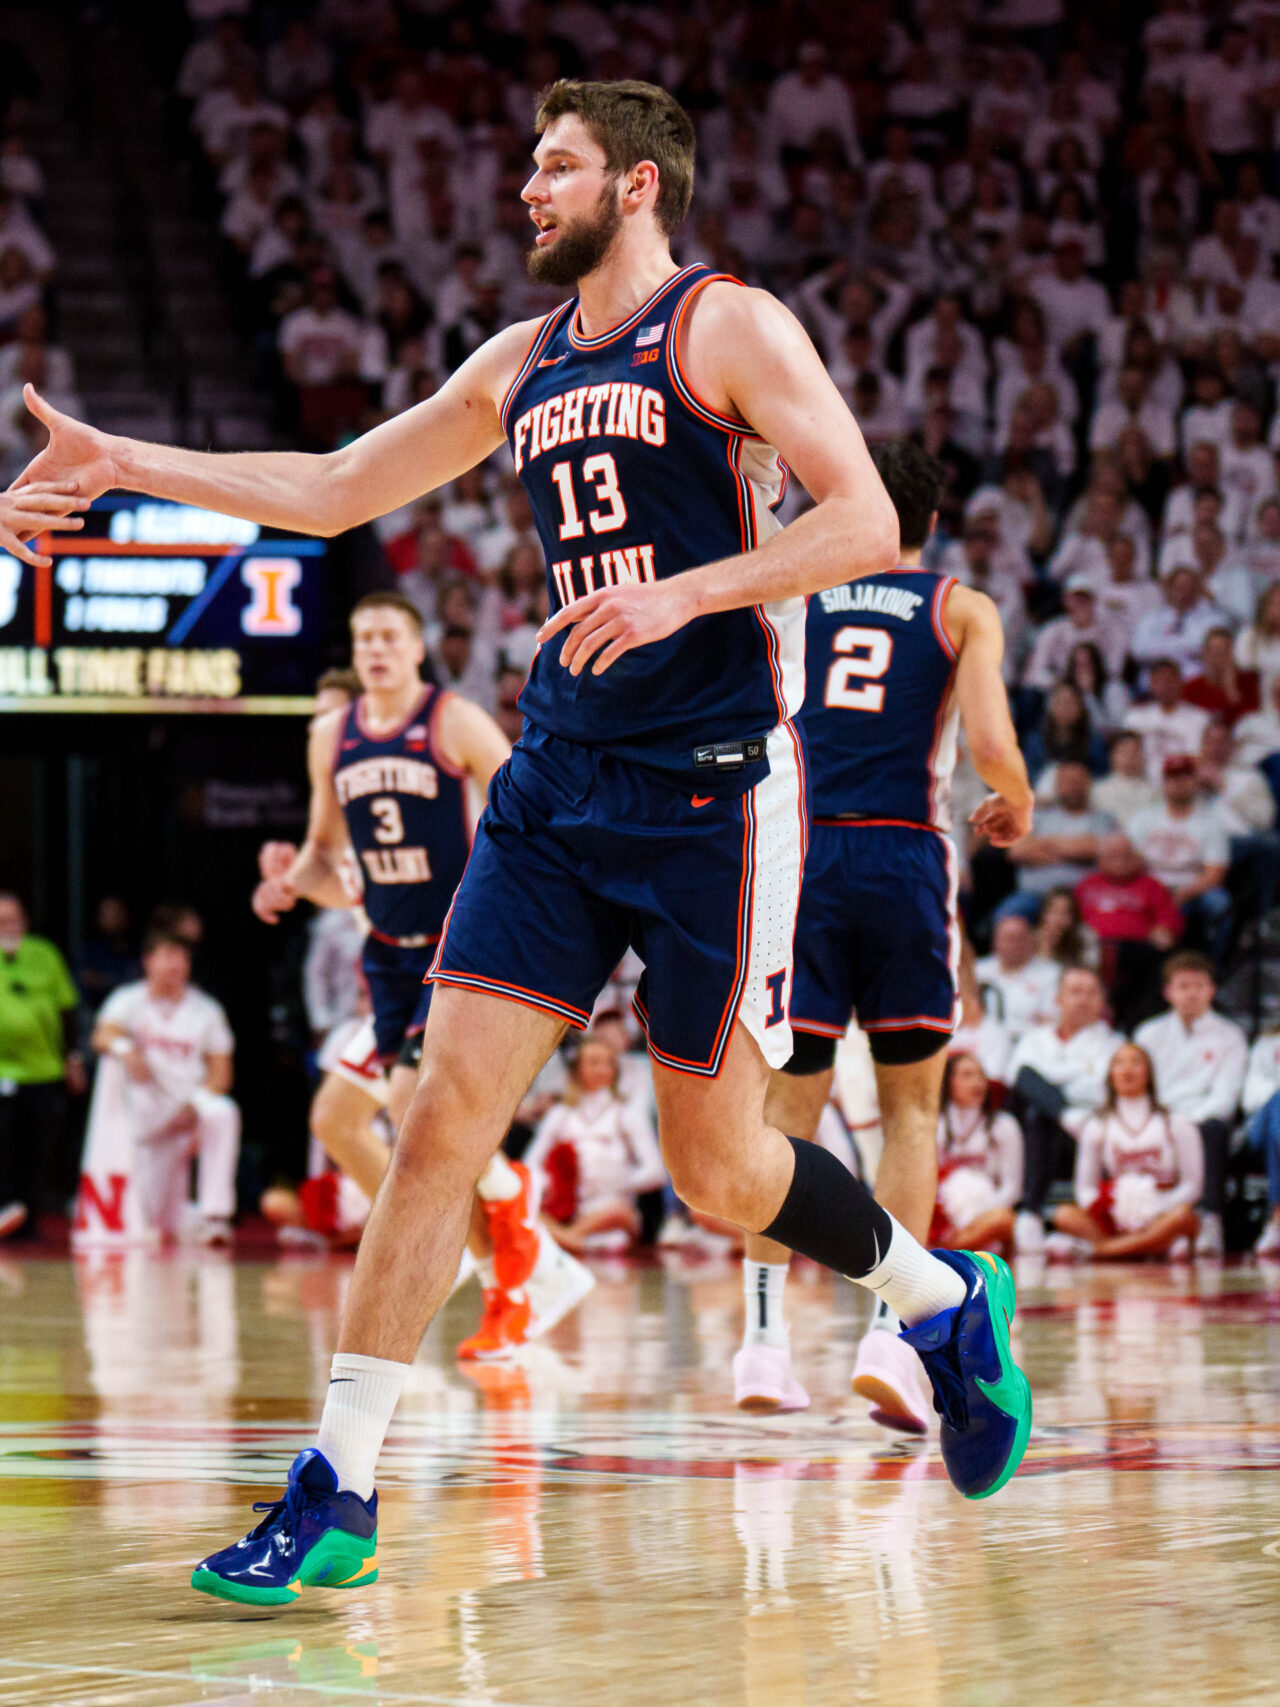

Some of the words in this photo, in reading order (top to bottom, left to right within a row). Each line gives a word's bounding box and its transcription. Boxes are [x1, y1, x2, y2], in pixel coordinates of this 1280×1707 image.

[514, 382, 667, 477] FIGHTING
[551, 452, 628, 541] 13
[146, 646, 242, 697] FANS
[825, 626, 894, 712] 2
[334, 756, 439, 807] FIGHTING
[371, 797, 405, 845] 3
[361, 847, 433, 885] ILLINI
[75, 1173, 128, 1233] N
